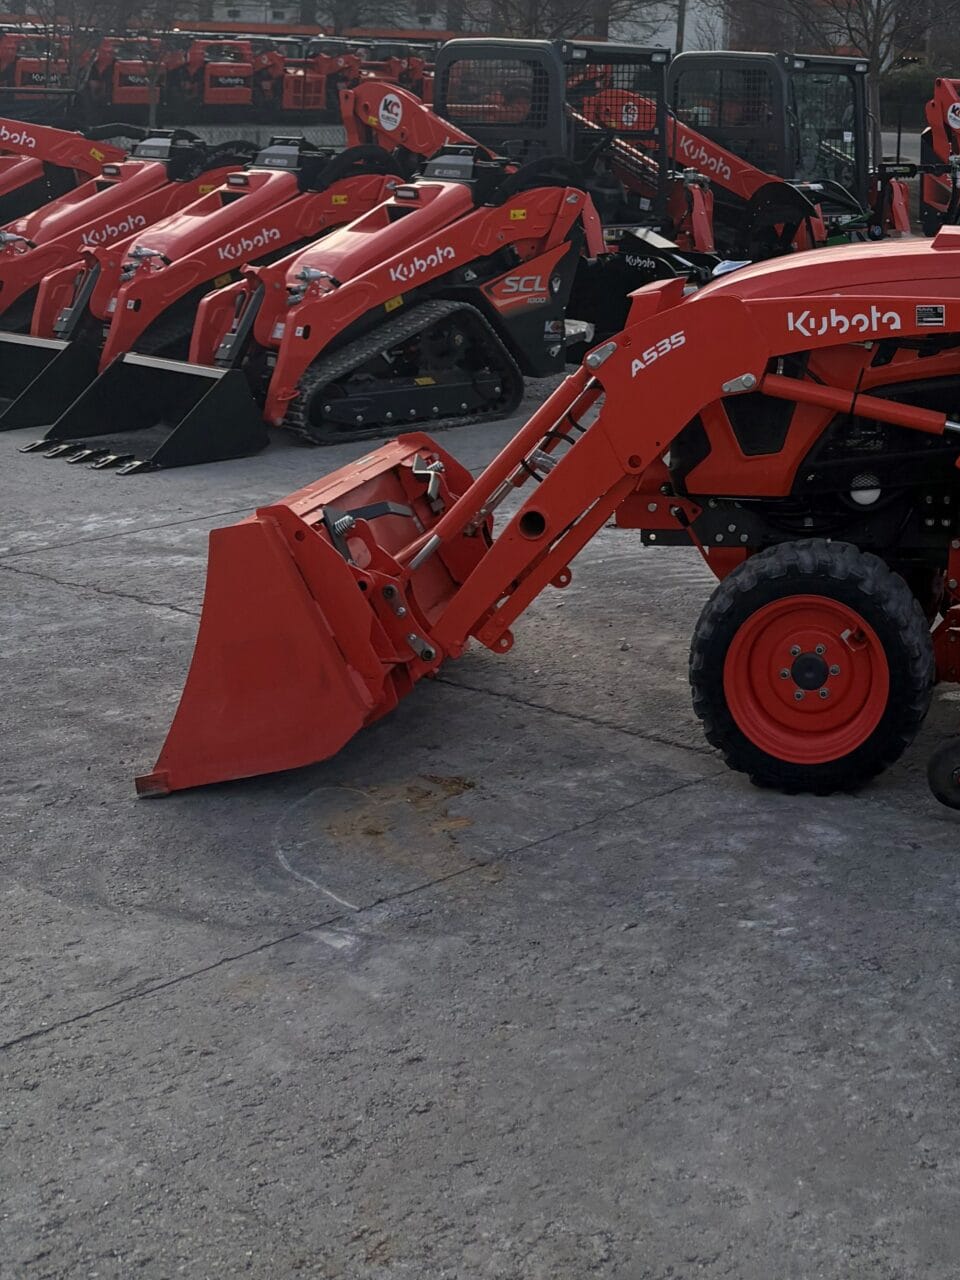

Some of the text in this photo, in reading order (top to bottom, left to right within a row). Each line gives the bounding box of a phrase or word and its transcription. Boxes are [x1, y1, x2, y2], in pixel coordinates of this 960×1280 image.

[0, 126, 36, 148] bota
[680, 135, 731, 181] Kubota
[82, 214, 146, 246] Kubota
[218, 228, 280, 260] Kubota
[389, 246, 455, 282] Kubota
[625, 255, 656, 269] Kubota
[502, 276, 546, 292] SCL
[787, 305, 901, 337] Kubota
[631, 330, 686, 377] A535
